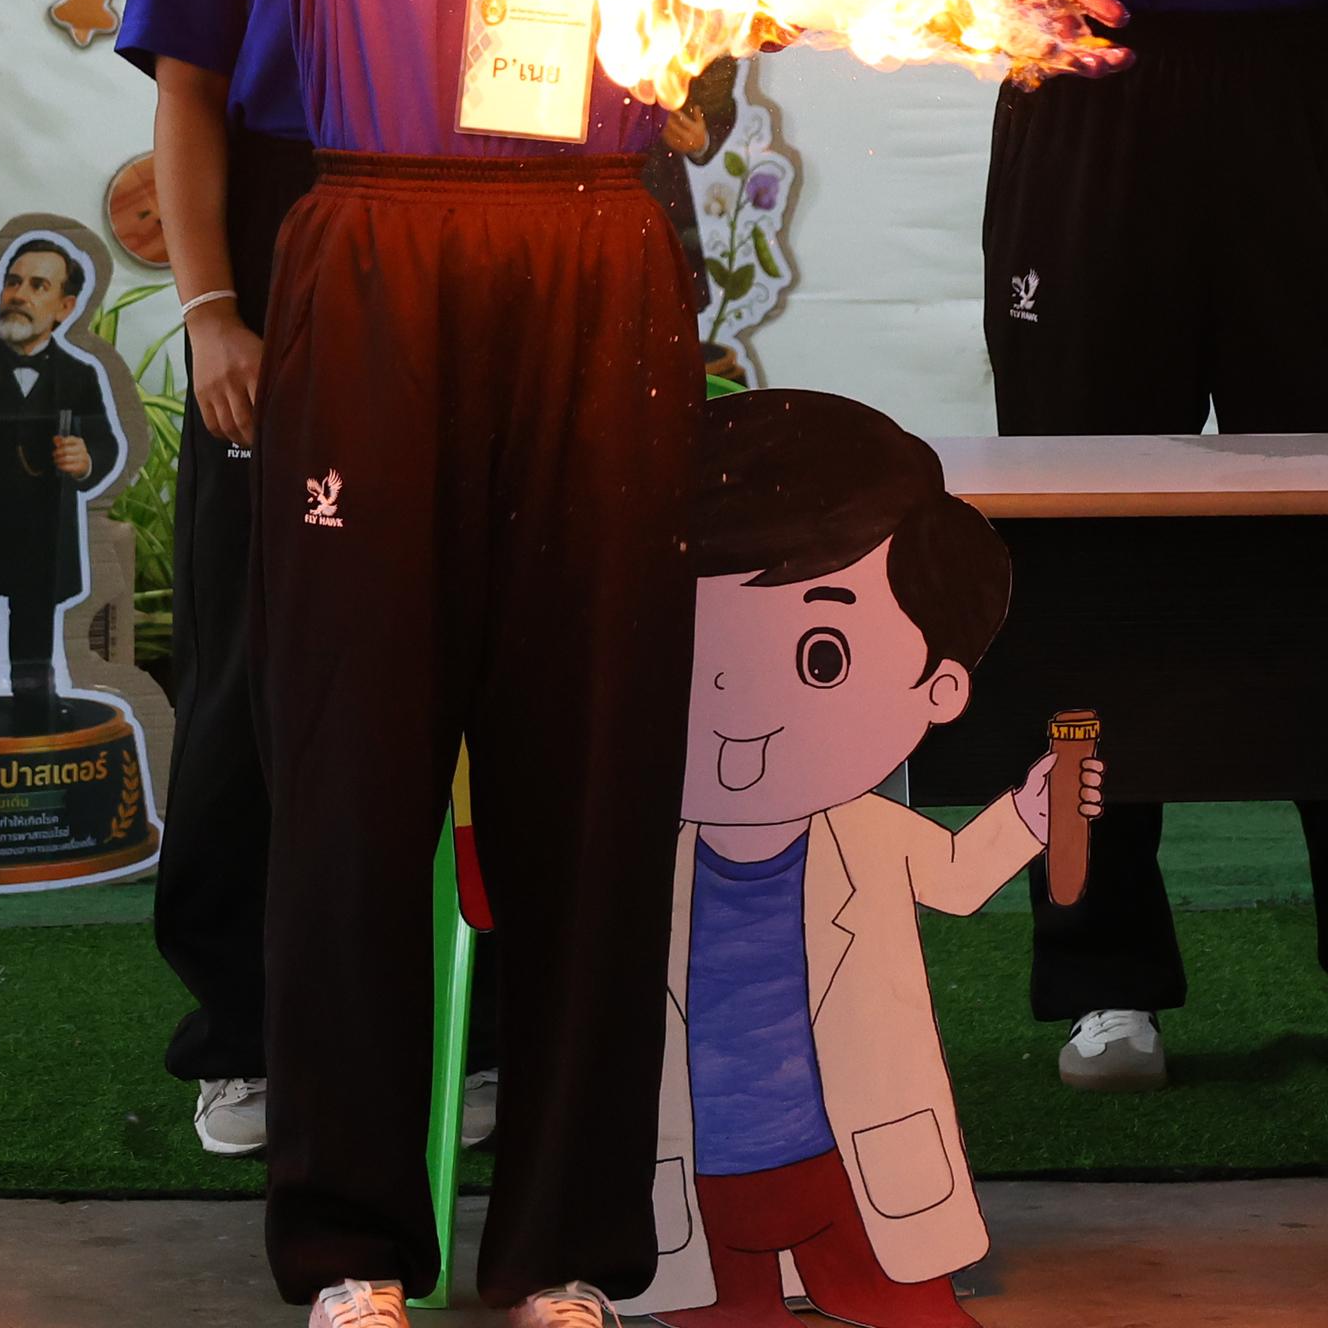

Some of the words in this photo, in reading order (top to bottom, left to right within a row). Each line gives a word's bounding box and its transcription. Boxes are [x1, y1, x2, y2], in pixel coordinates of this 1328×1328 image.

[304, 513, 318, 525] FLY
[319, 516, 344, 528] HAWK
[0, 751, 109, 789] ปาสเตอร์
